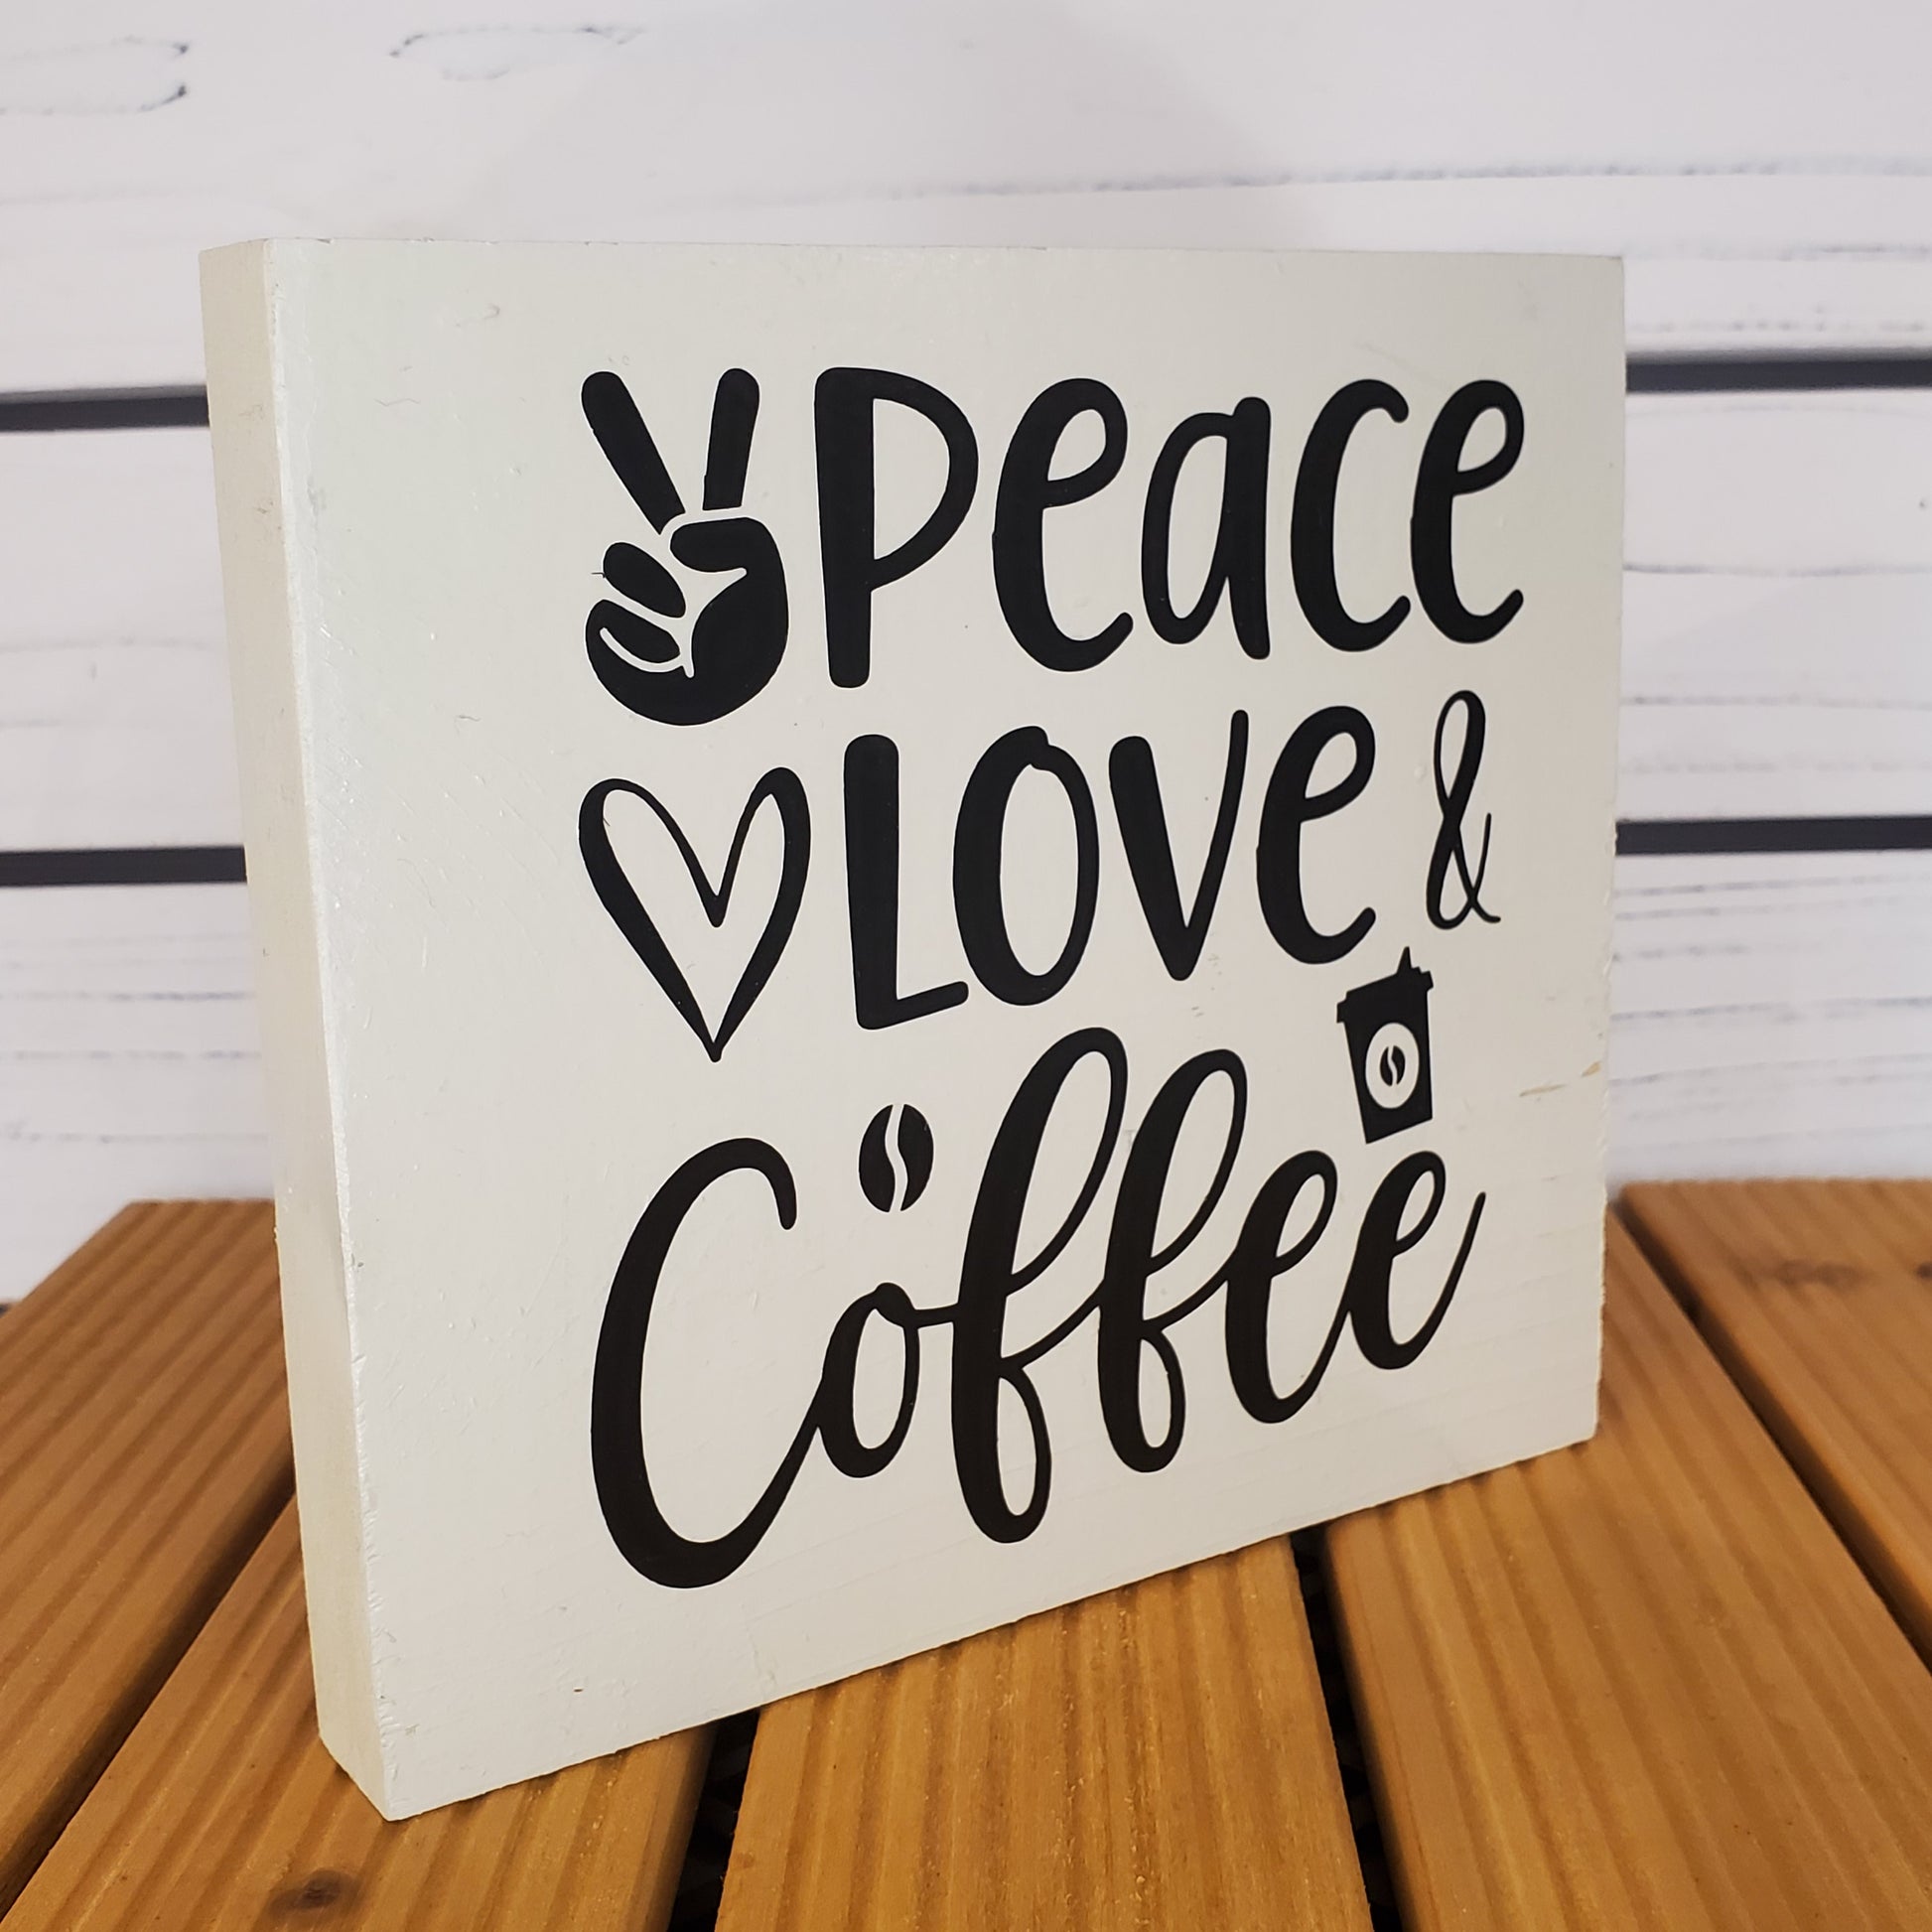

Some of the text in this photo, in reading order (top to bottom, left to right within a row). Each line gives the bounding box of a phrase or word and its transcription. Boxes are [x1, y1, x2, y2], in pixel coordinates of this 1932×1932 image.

[813, 366, 1526, 689] Peace
[1427, 690, 1501, 930] &
[591, 1027, 1486, 1589] Coffee
